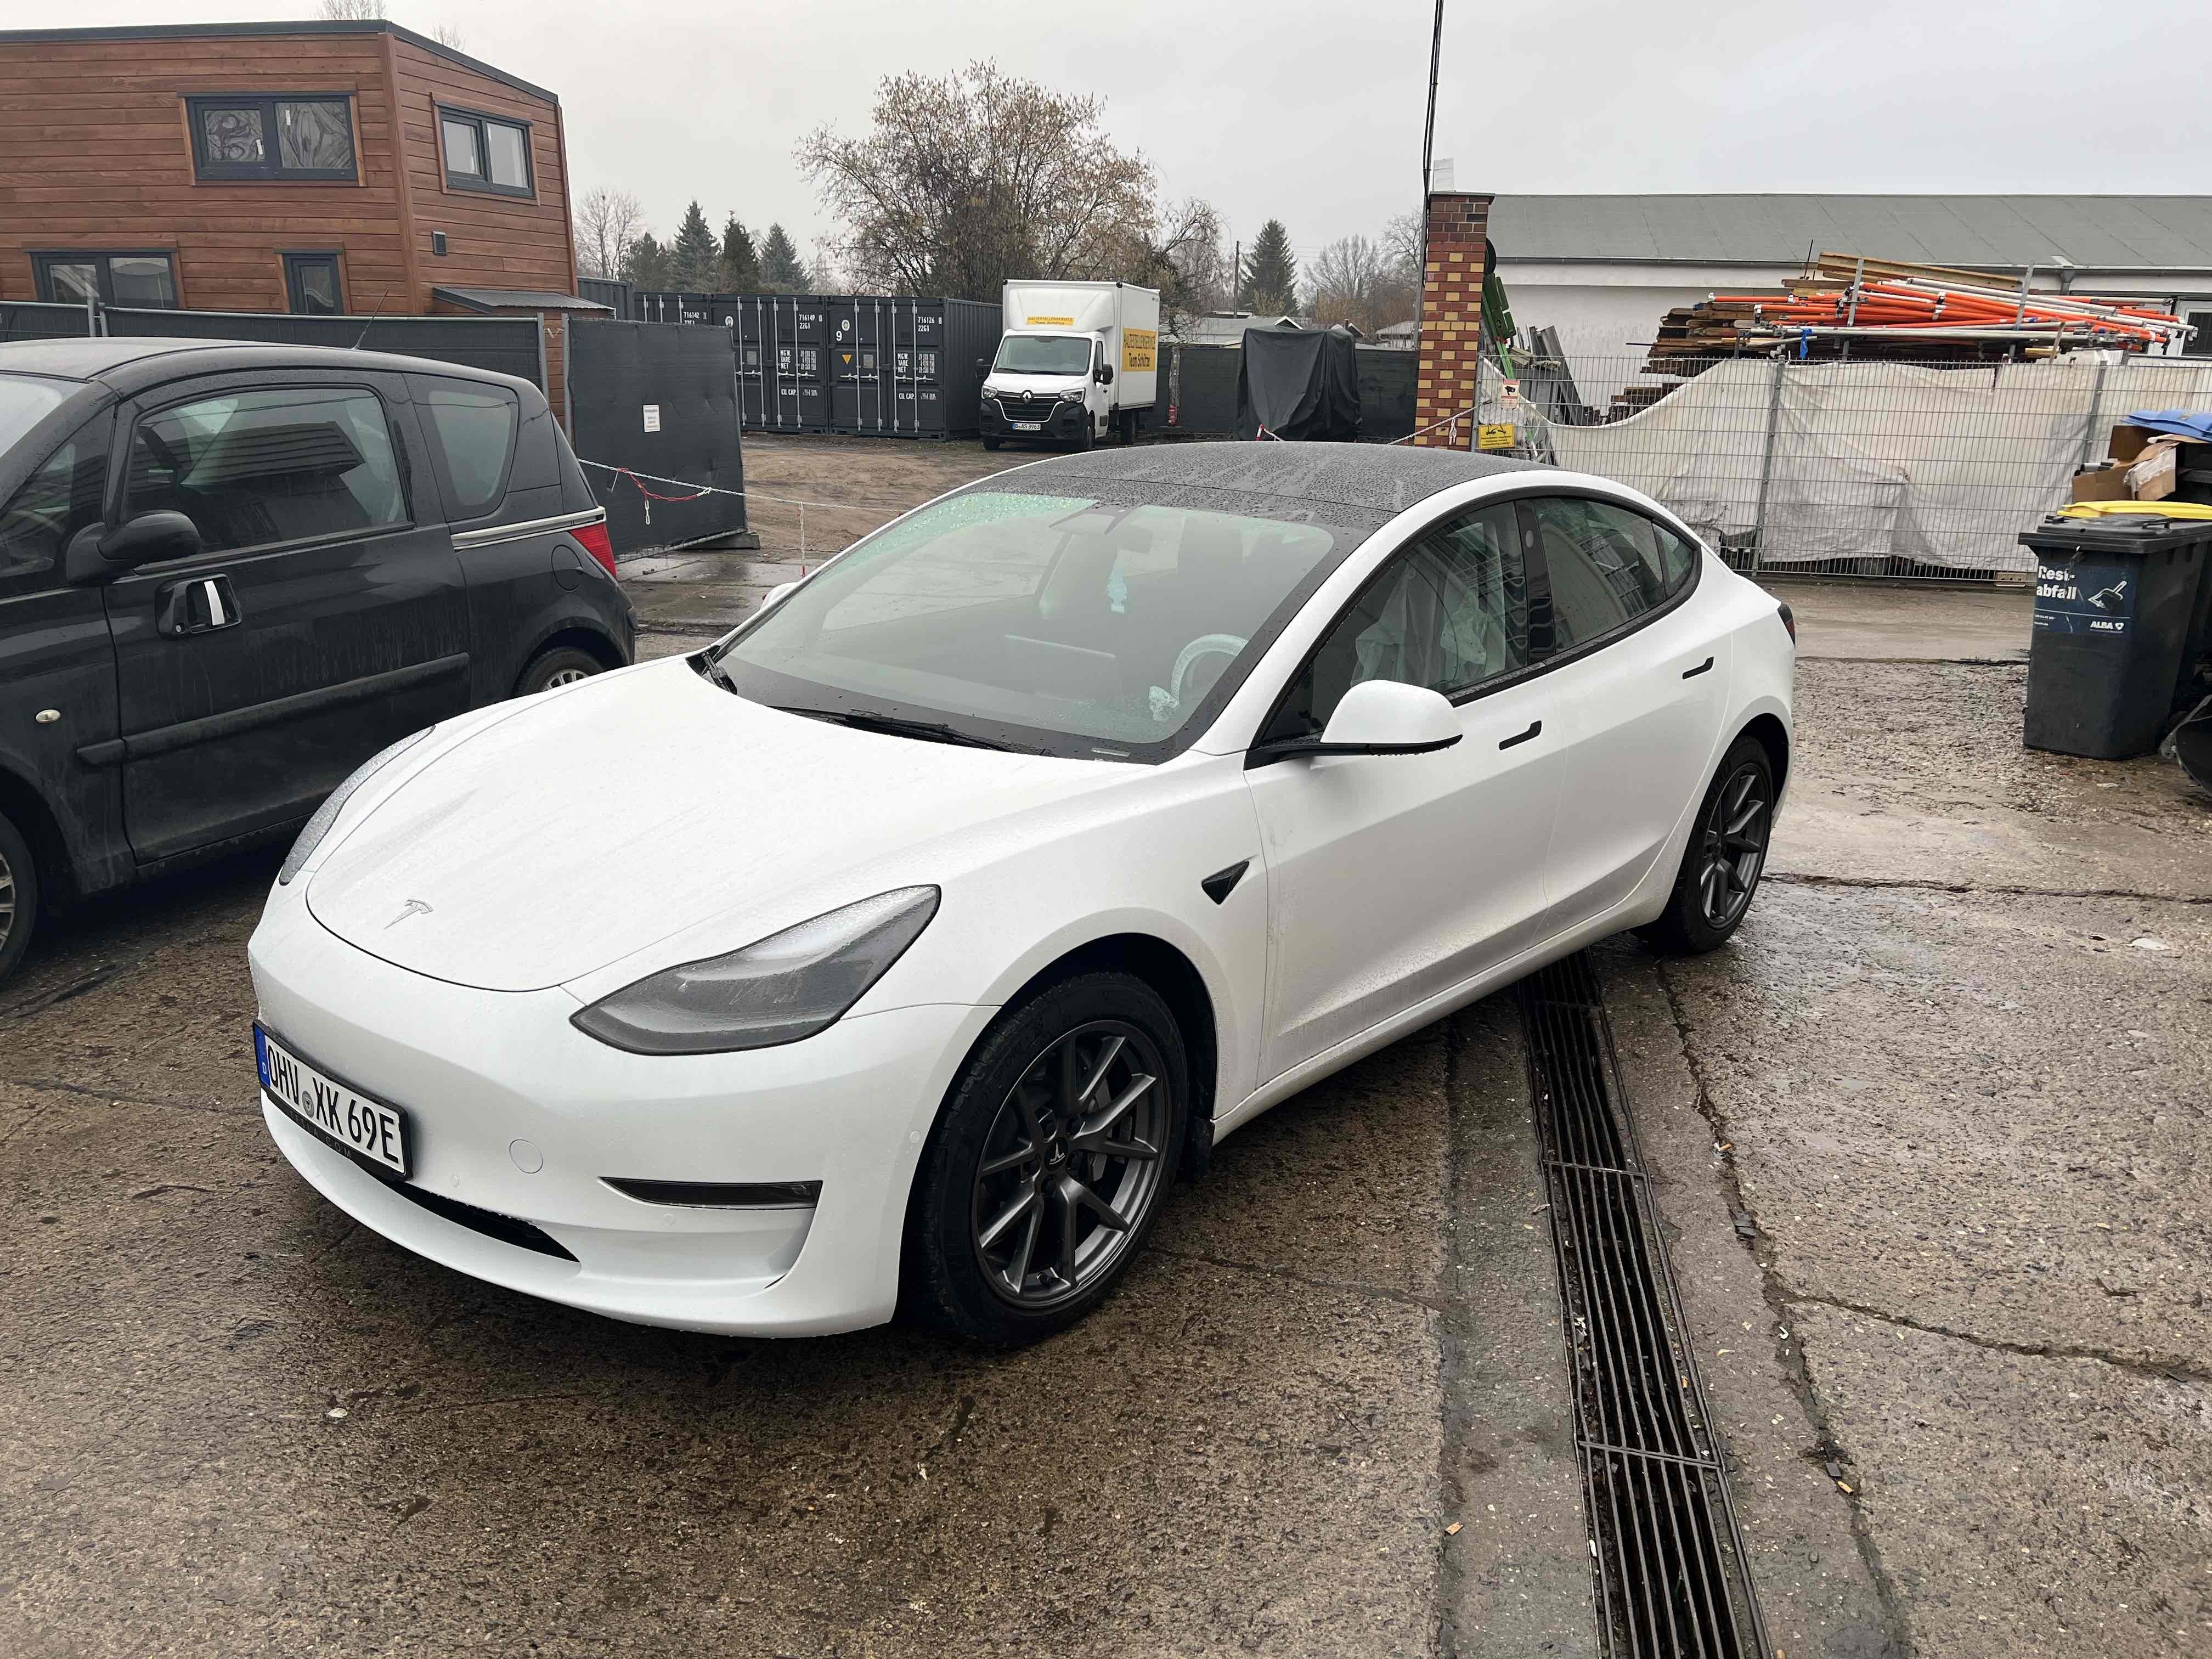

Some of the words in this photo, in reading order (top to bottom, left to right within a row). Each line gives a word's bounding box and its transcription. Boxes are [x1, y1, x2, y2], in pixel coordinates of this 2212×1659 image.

[836, 330, 843, 341] 9
[1128, 352, 1137, 368] Team
[2038, 565, 2075, 582] Rest-
[2036, 583, 2078, 600] abfall
[2090, 620, 2114, 629] ALBA
[267, 1044, 300, 1106] OHV
[312, 1075, 343, 1136] XK
[347, 1098, 399, 1164] 69E
